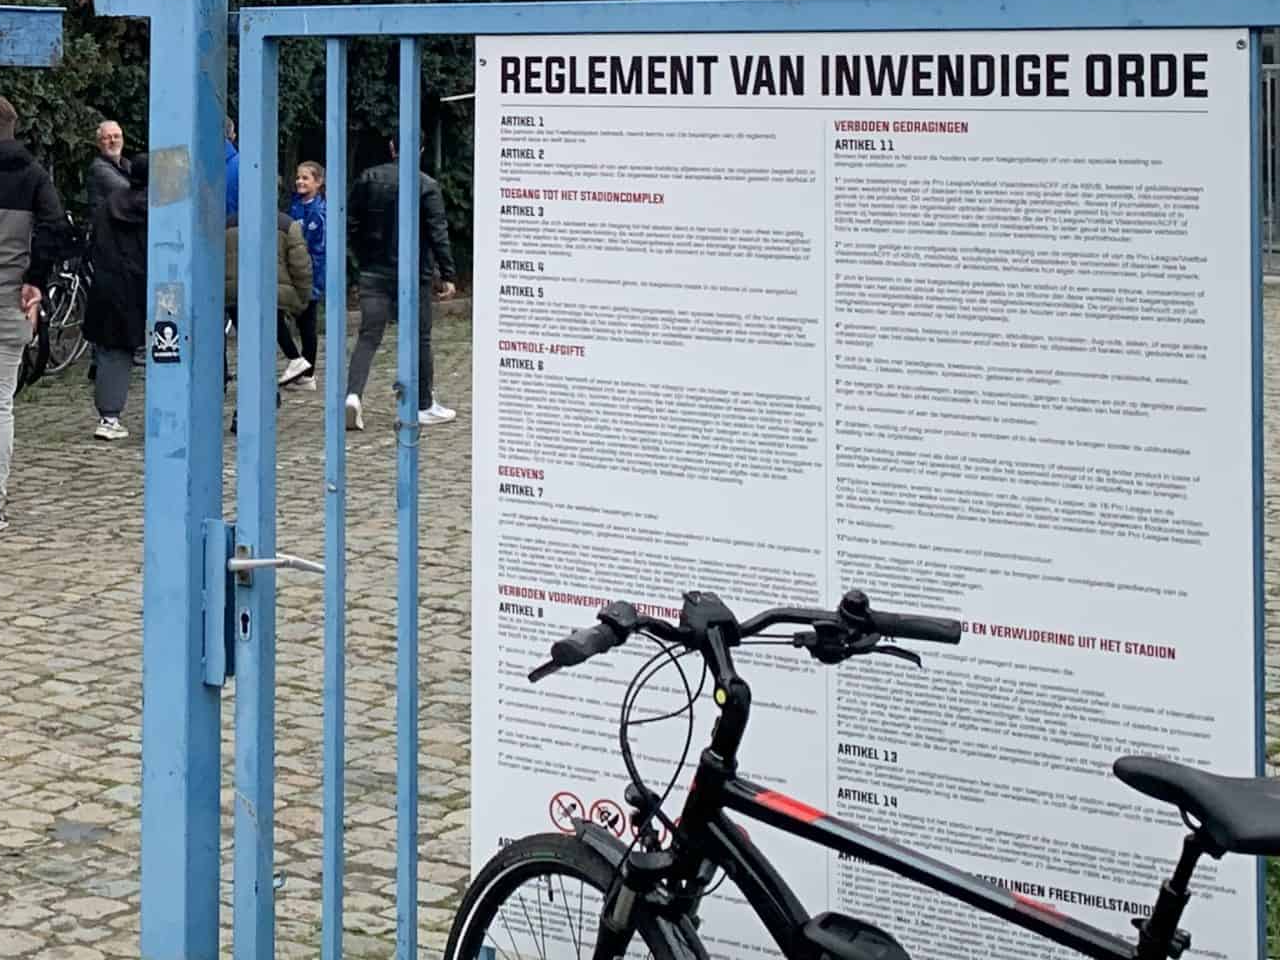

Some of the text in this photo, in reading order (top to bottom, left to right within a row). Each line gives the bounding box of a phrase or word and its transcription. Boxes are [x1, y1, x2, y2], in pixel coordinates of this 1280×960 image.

[501, 54, 1208, 97] REGLEMENT VAN INWENDIGE ORDE
[500, 115, 545, 128] ARTIKEL 1
[834, 120, 969, 134] VERBODEN GEDRAGINGEN
[834, 138, 895, 152] ARTIKEL 11
[500, 147, 545, 160] ARTIKEL 2
[499, 187, 665, 205] TOEGANG TOT HET STADIONCOMPLEX
[500, 204, 545, 217] ARTIKEL 3
[499, 259, 545, 273] ARTIKEL 4
[499, 284, 535, 298] ARTIKEL
[537, 287, 544, 299] 5
[498, 339, 585, 358] CONTROLE-AFGIFTE
[499, 357, 536, 371] ARTIKEL
[498, 465, 545, 481] GEGEVENS
[499, 482, 544, 498] ARTIKEL 7
[498, 583, 546, 601] VERBODEN
[498, 601, 535, 617] ARTIKEL
[972, 622, 987, 636] EN
[989, 624, 1075, 647] VERWIJDERING
[1077, 635, 1097, 649] UIT
[1099, 638, 1122, 653] HET
[1124, 641, 1176, 660] STADION
[837, 742, 898, 764] ARTIKEL 13
[837, 787, 898, 809] ARTIKEL 14
